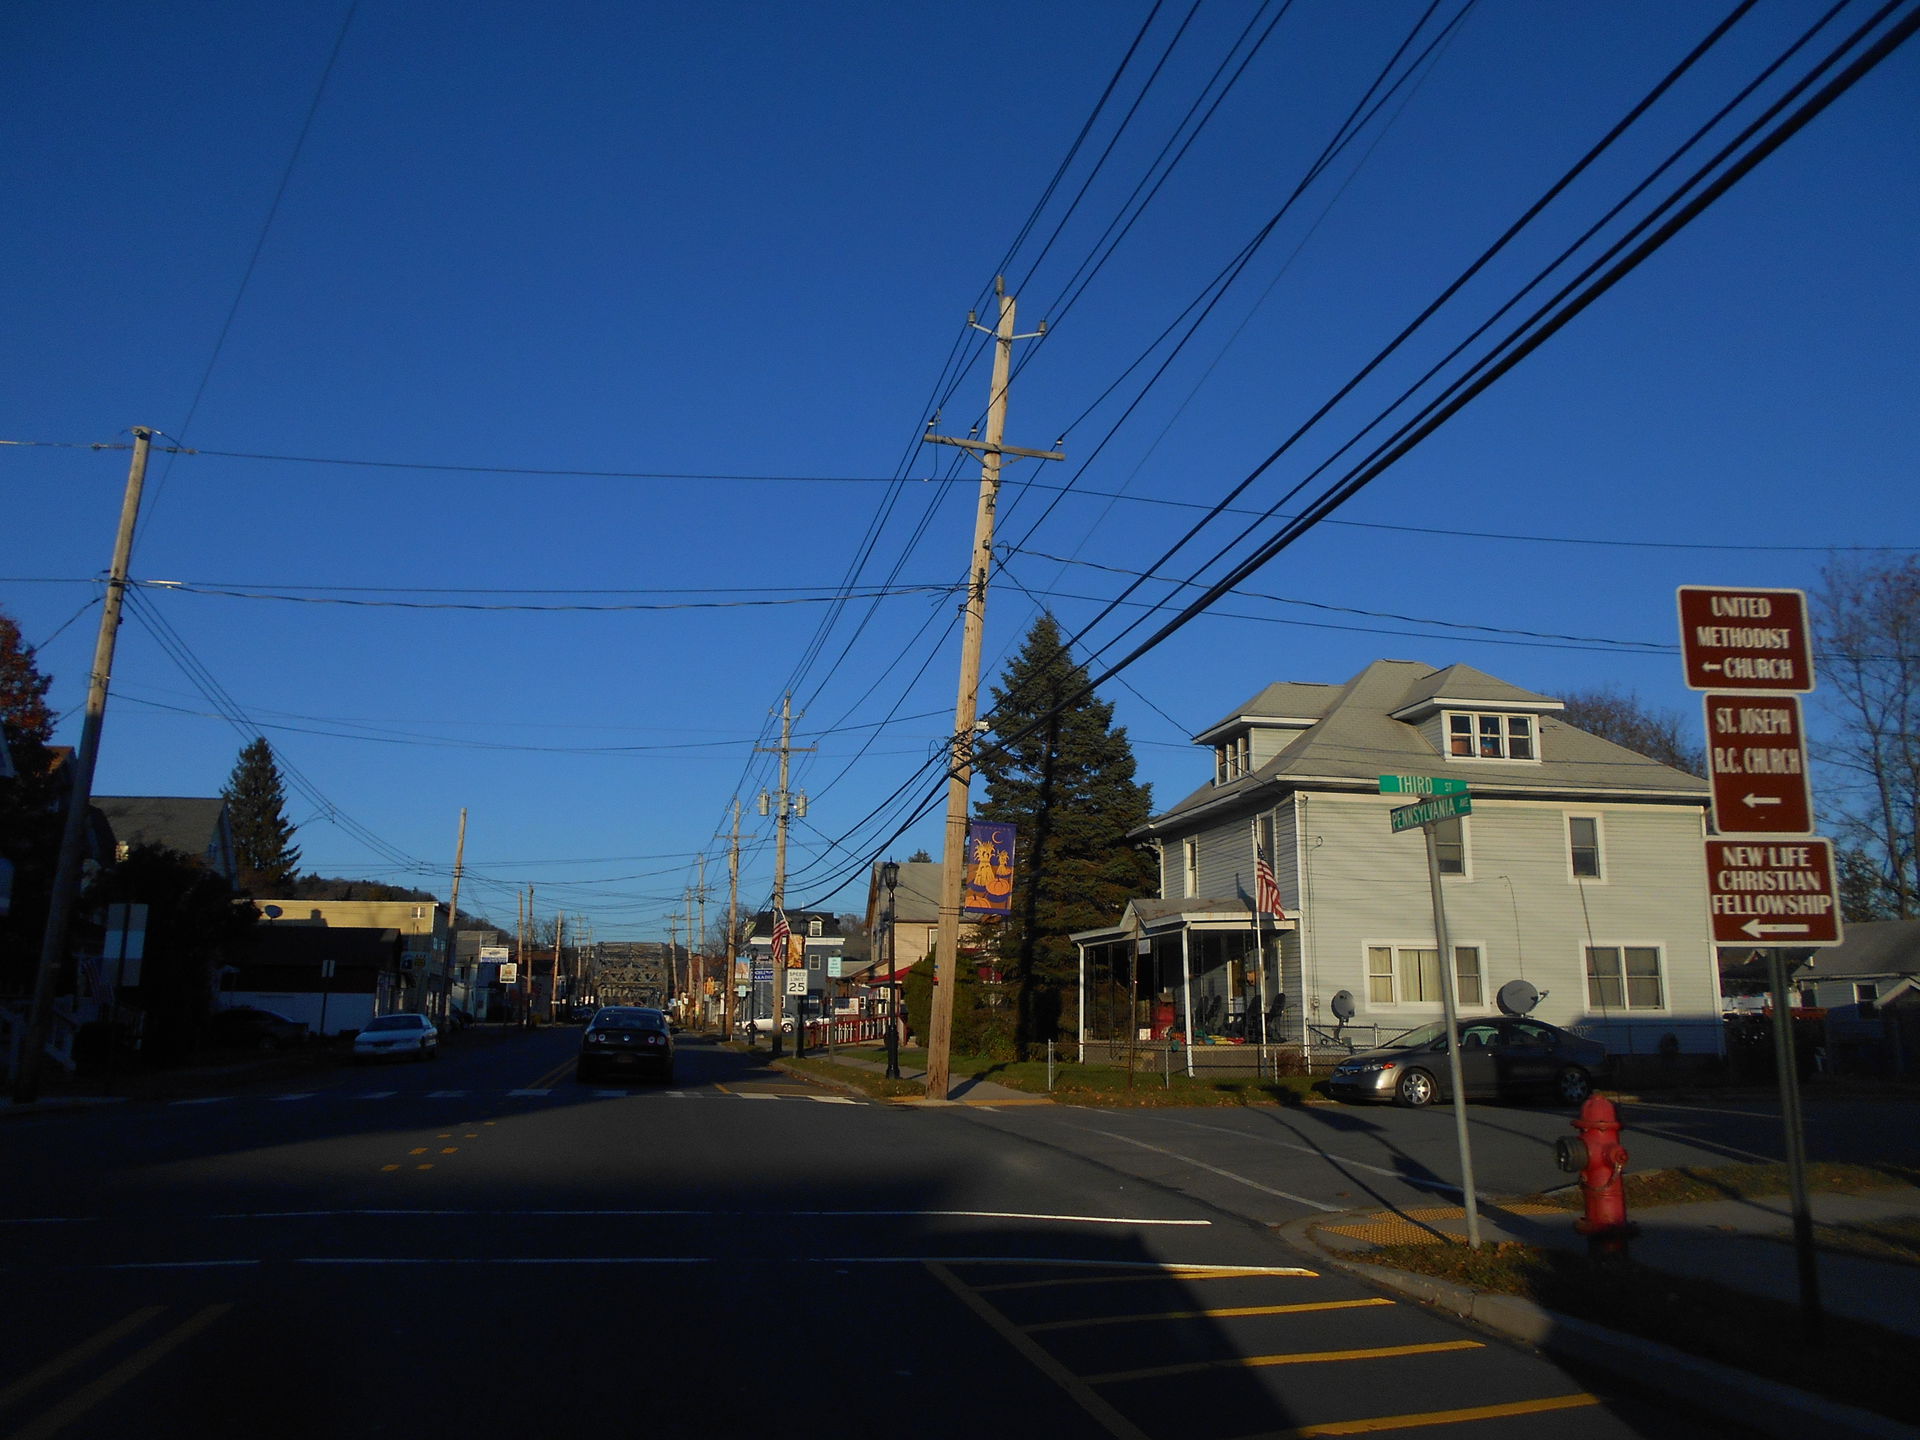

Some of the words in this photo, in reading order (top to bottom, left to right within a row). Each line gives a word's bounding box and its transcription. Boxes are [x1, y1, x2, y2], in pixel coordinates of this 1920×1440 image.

[1711, 597, 1771, 618] UNITED
[1697, 627, 1791, 650] METHODIST
[1723, 658, 1793, 680] CHURCH
[1716, 708, 1736, 734] ST.
[1740, 708, 1790, 735] JOSEPH
[1714, 747, 1742, 774] R.C.
[1743, 748, 1800, 774] CHURCH
[1397, 776, 1433, 794] THIRD
[1445, 782, 1452, 792] ST
[1392, 798, 1456, 830] PENNSYLVANIA
[1460, 797, 1470, 807] AVE
[1722, 846, 1763, 867] NEW
[1768, 847, 1811, 867] LIFE
[1718, 870, 1821, 891] CHRISTIAN
[1712, 894, 1832, 916] FELLOWSHIP
[789, 982, 805, 992] 25
